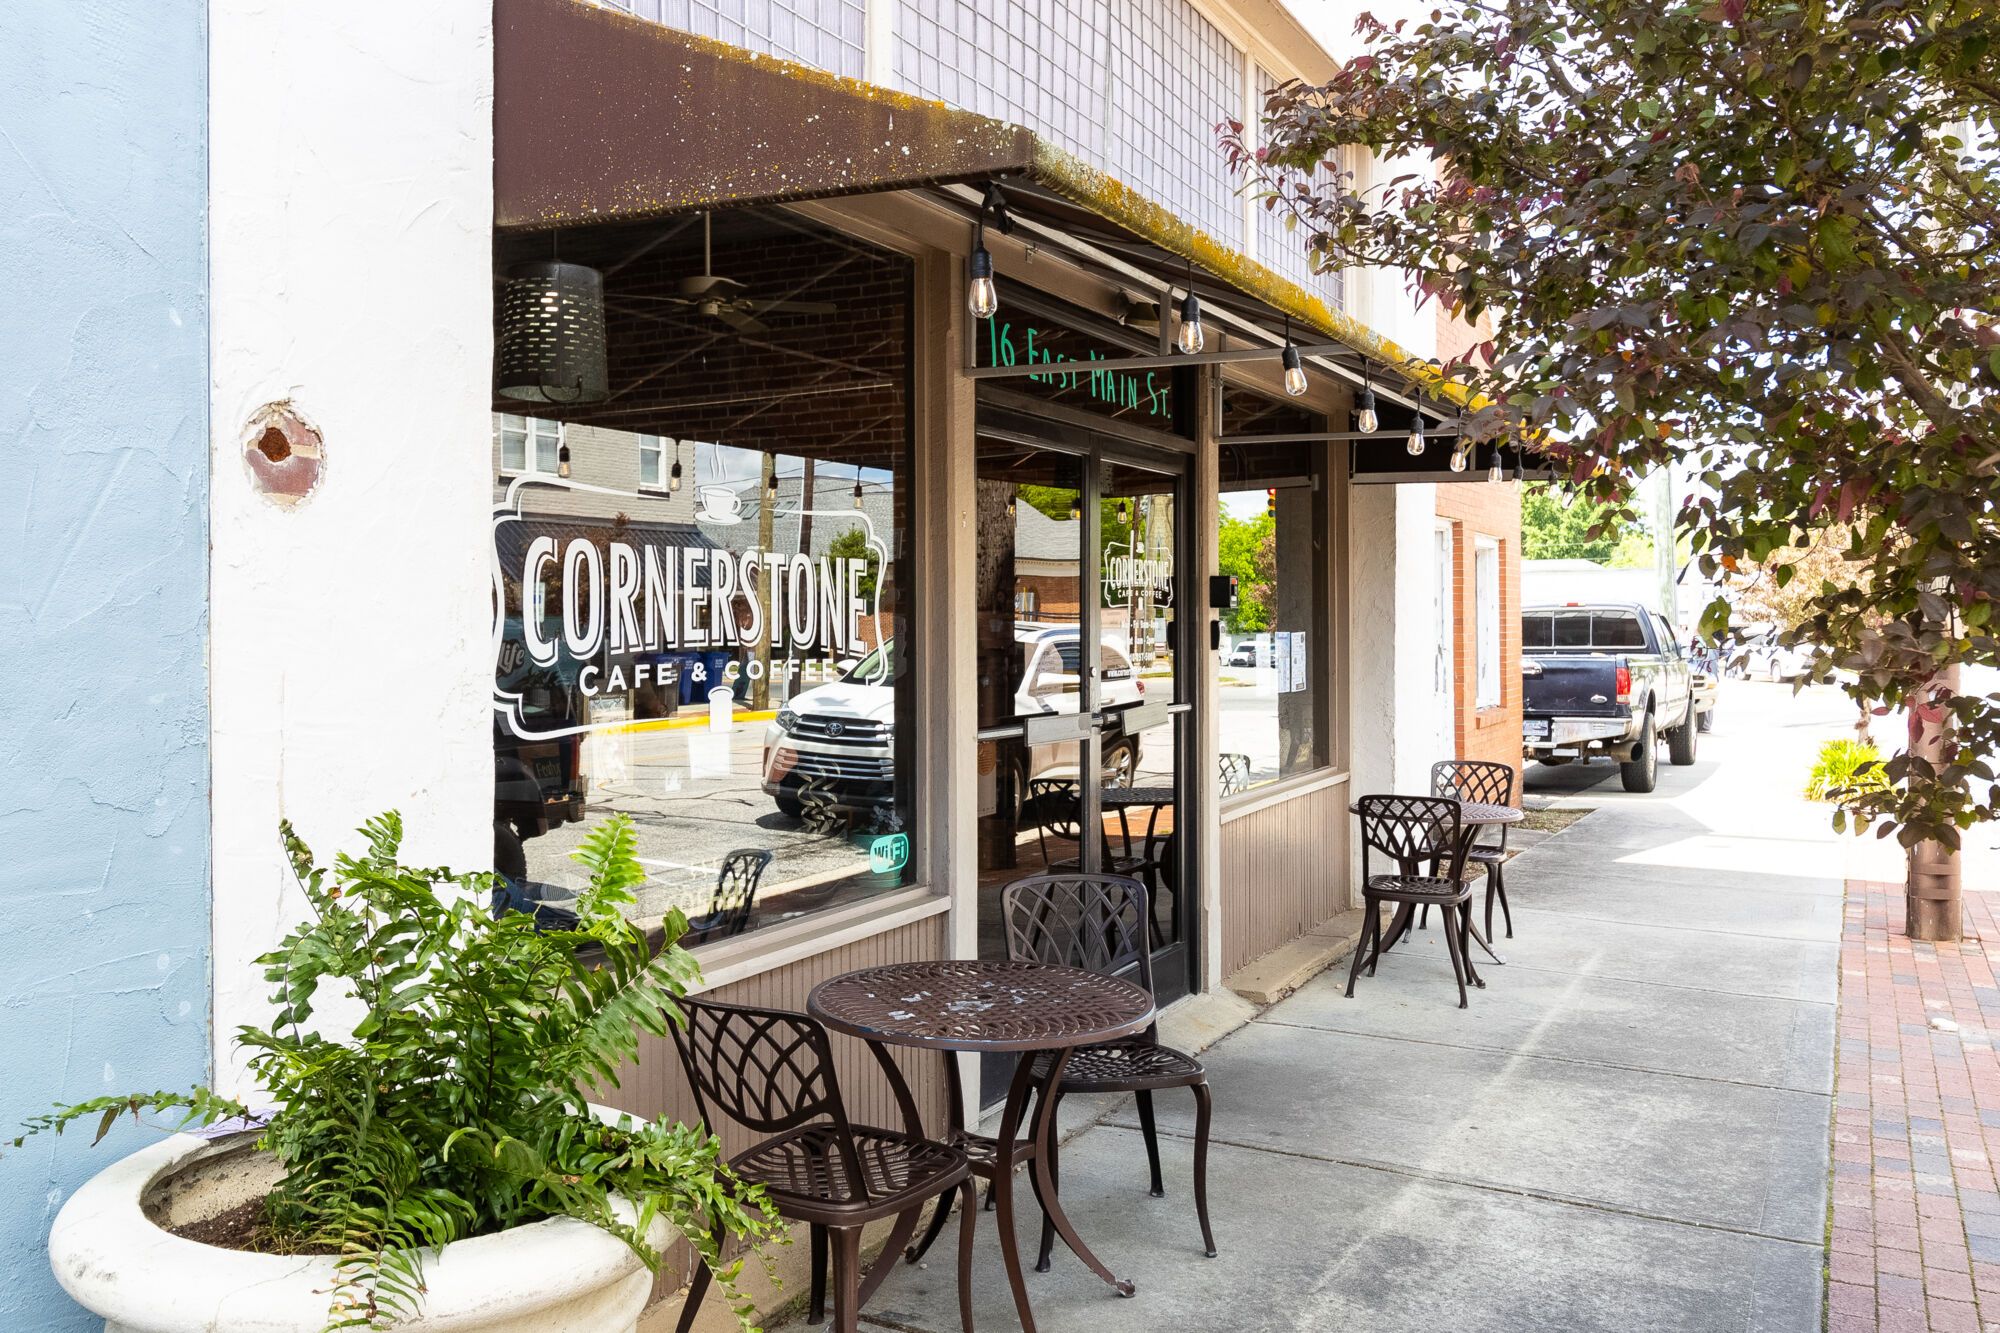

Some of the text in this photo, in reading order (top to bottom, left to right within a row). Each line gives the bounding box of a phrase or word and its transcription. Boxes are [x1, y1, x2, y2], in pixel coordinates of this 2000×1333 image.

[988, 315, 1015, 368] 16
[1028, 327, 1079, 390] EAST
[1090, 349, 1138, 410] MAIN
[522, 535, 869, 668] CORNERSTONE
[1110, 556, 1169, 592] CORNERSTONE
[579, 658, 834, 697] CAFE & COFFEE
